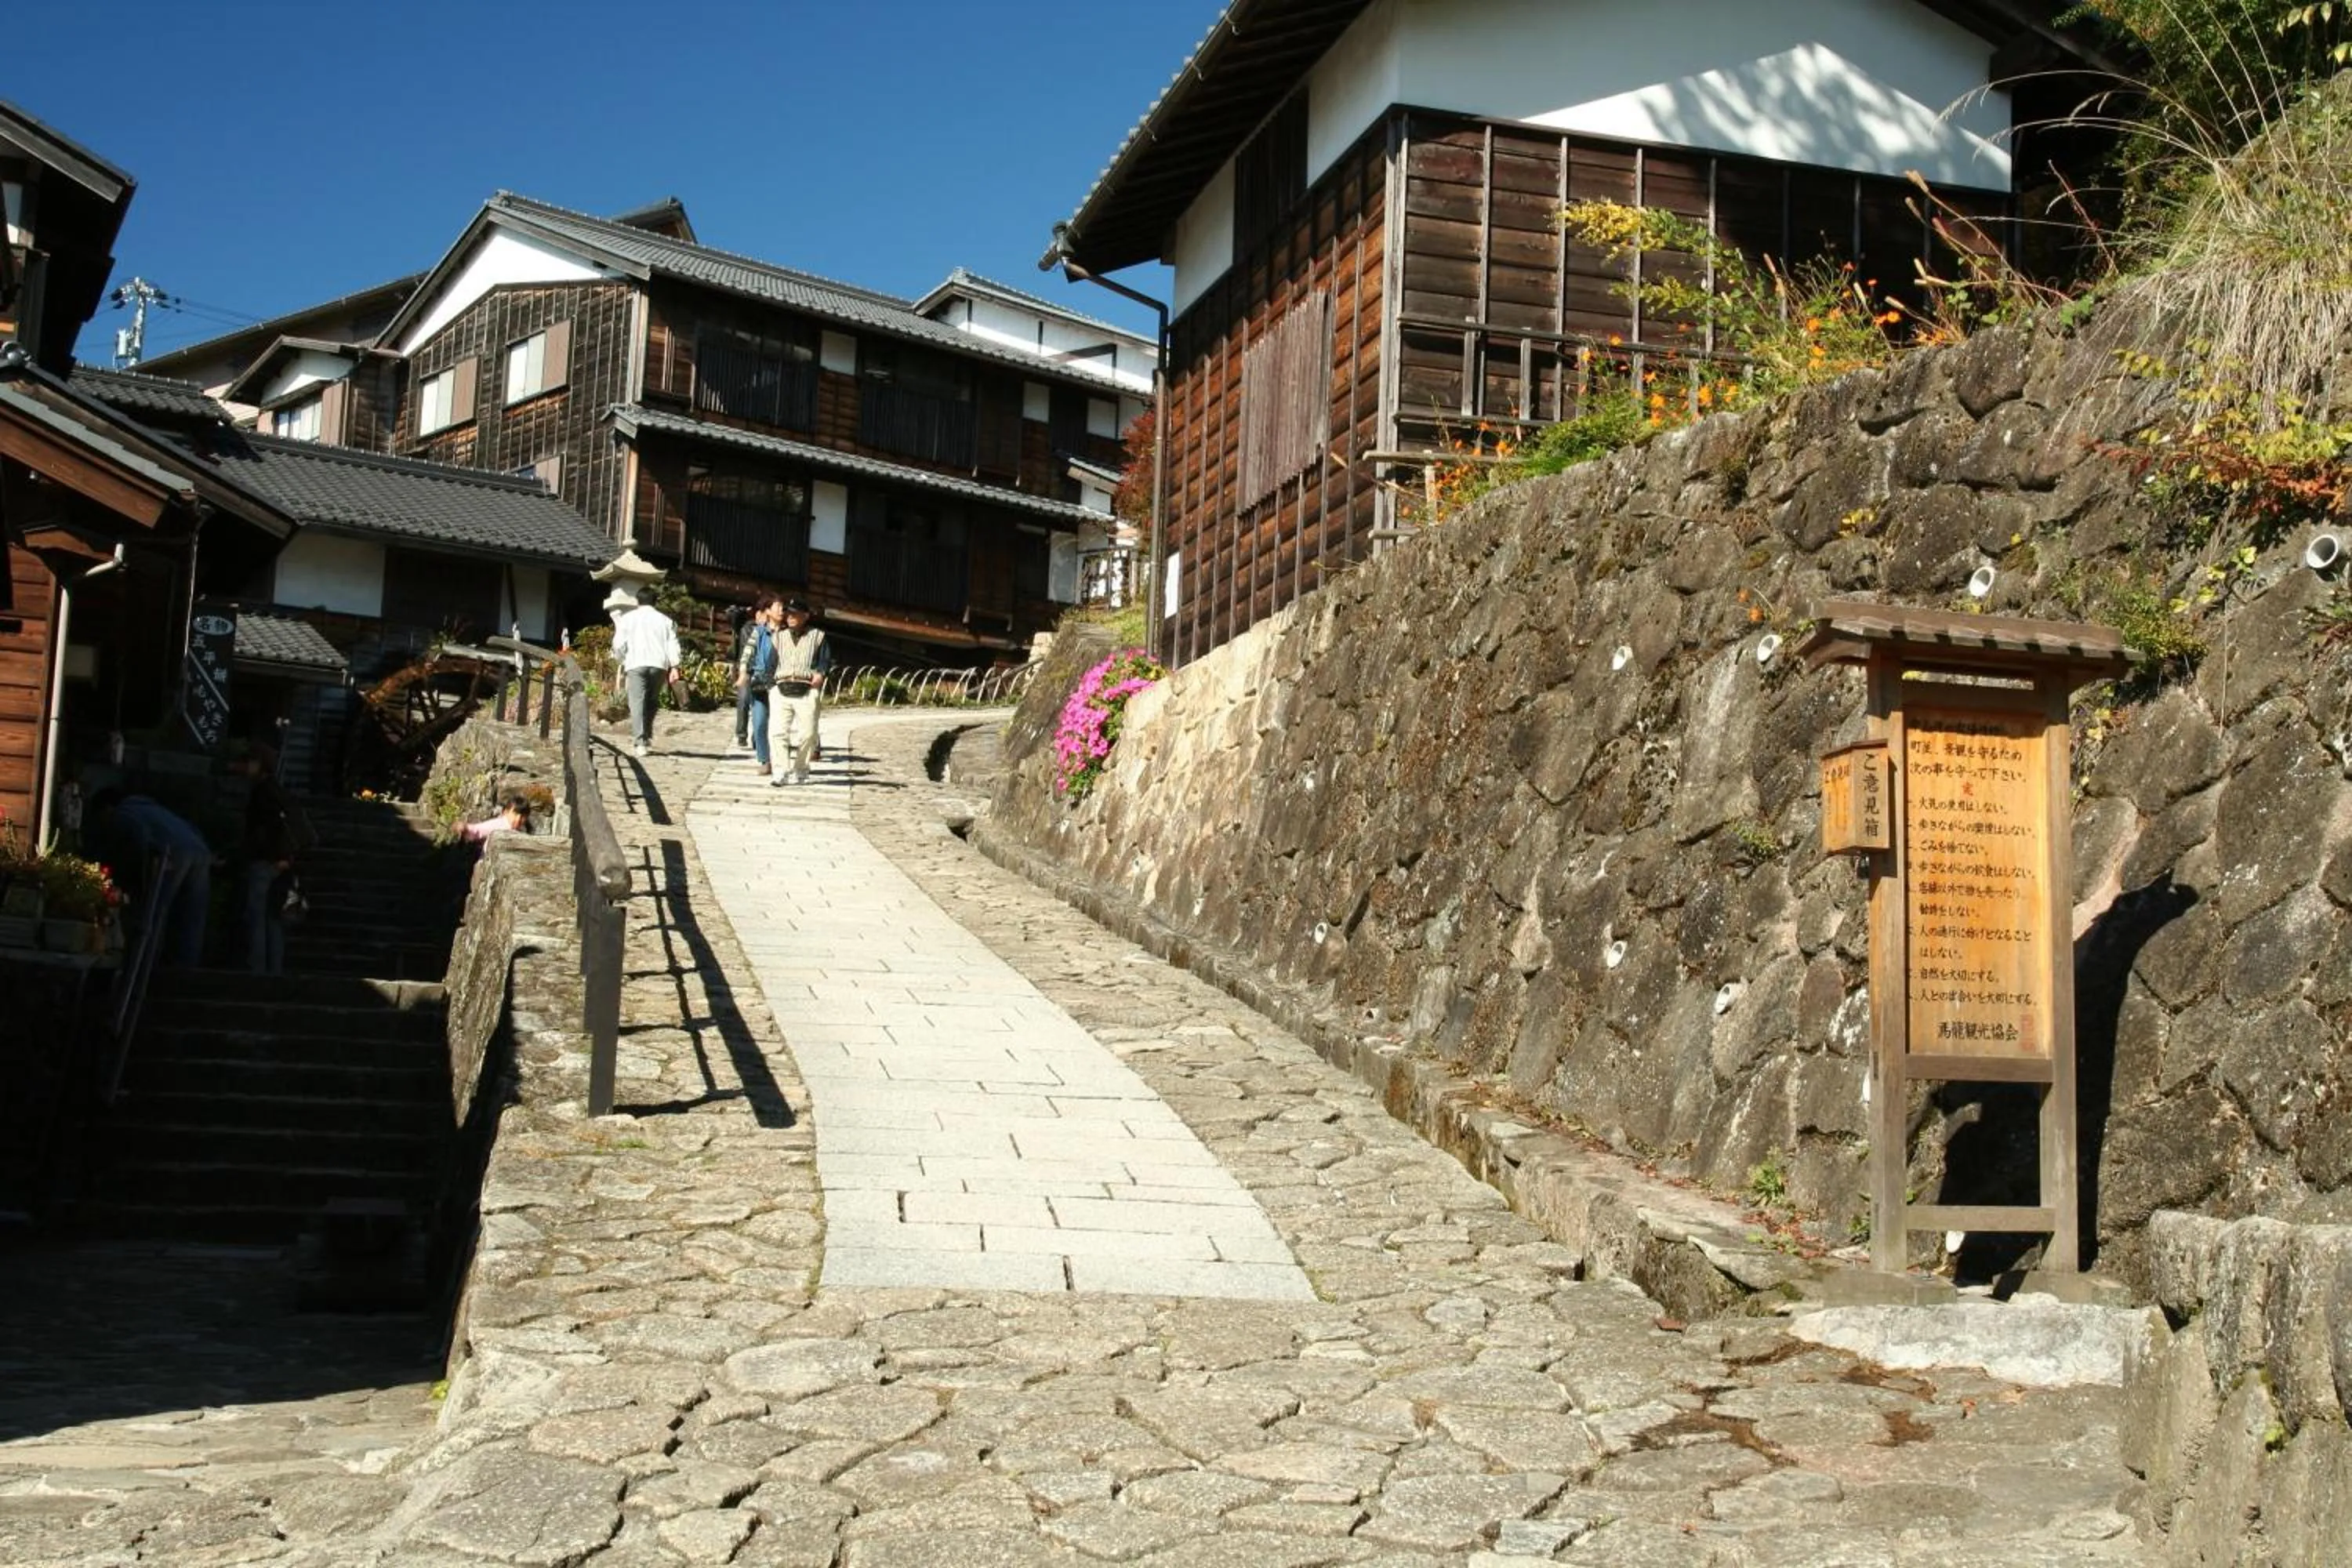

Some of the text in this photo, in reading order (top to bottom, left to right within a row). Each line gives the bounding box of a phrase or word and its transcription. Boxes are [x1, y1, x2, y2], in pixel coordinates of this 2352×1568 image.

[200, 617, 228, 632] 名物
[1863, 753, 1879, 837] ご意見箱
